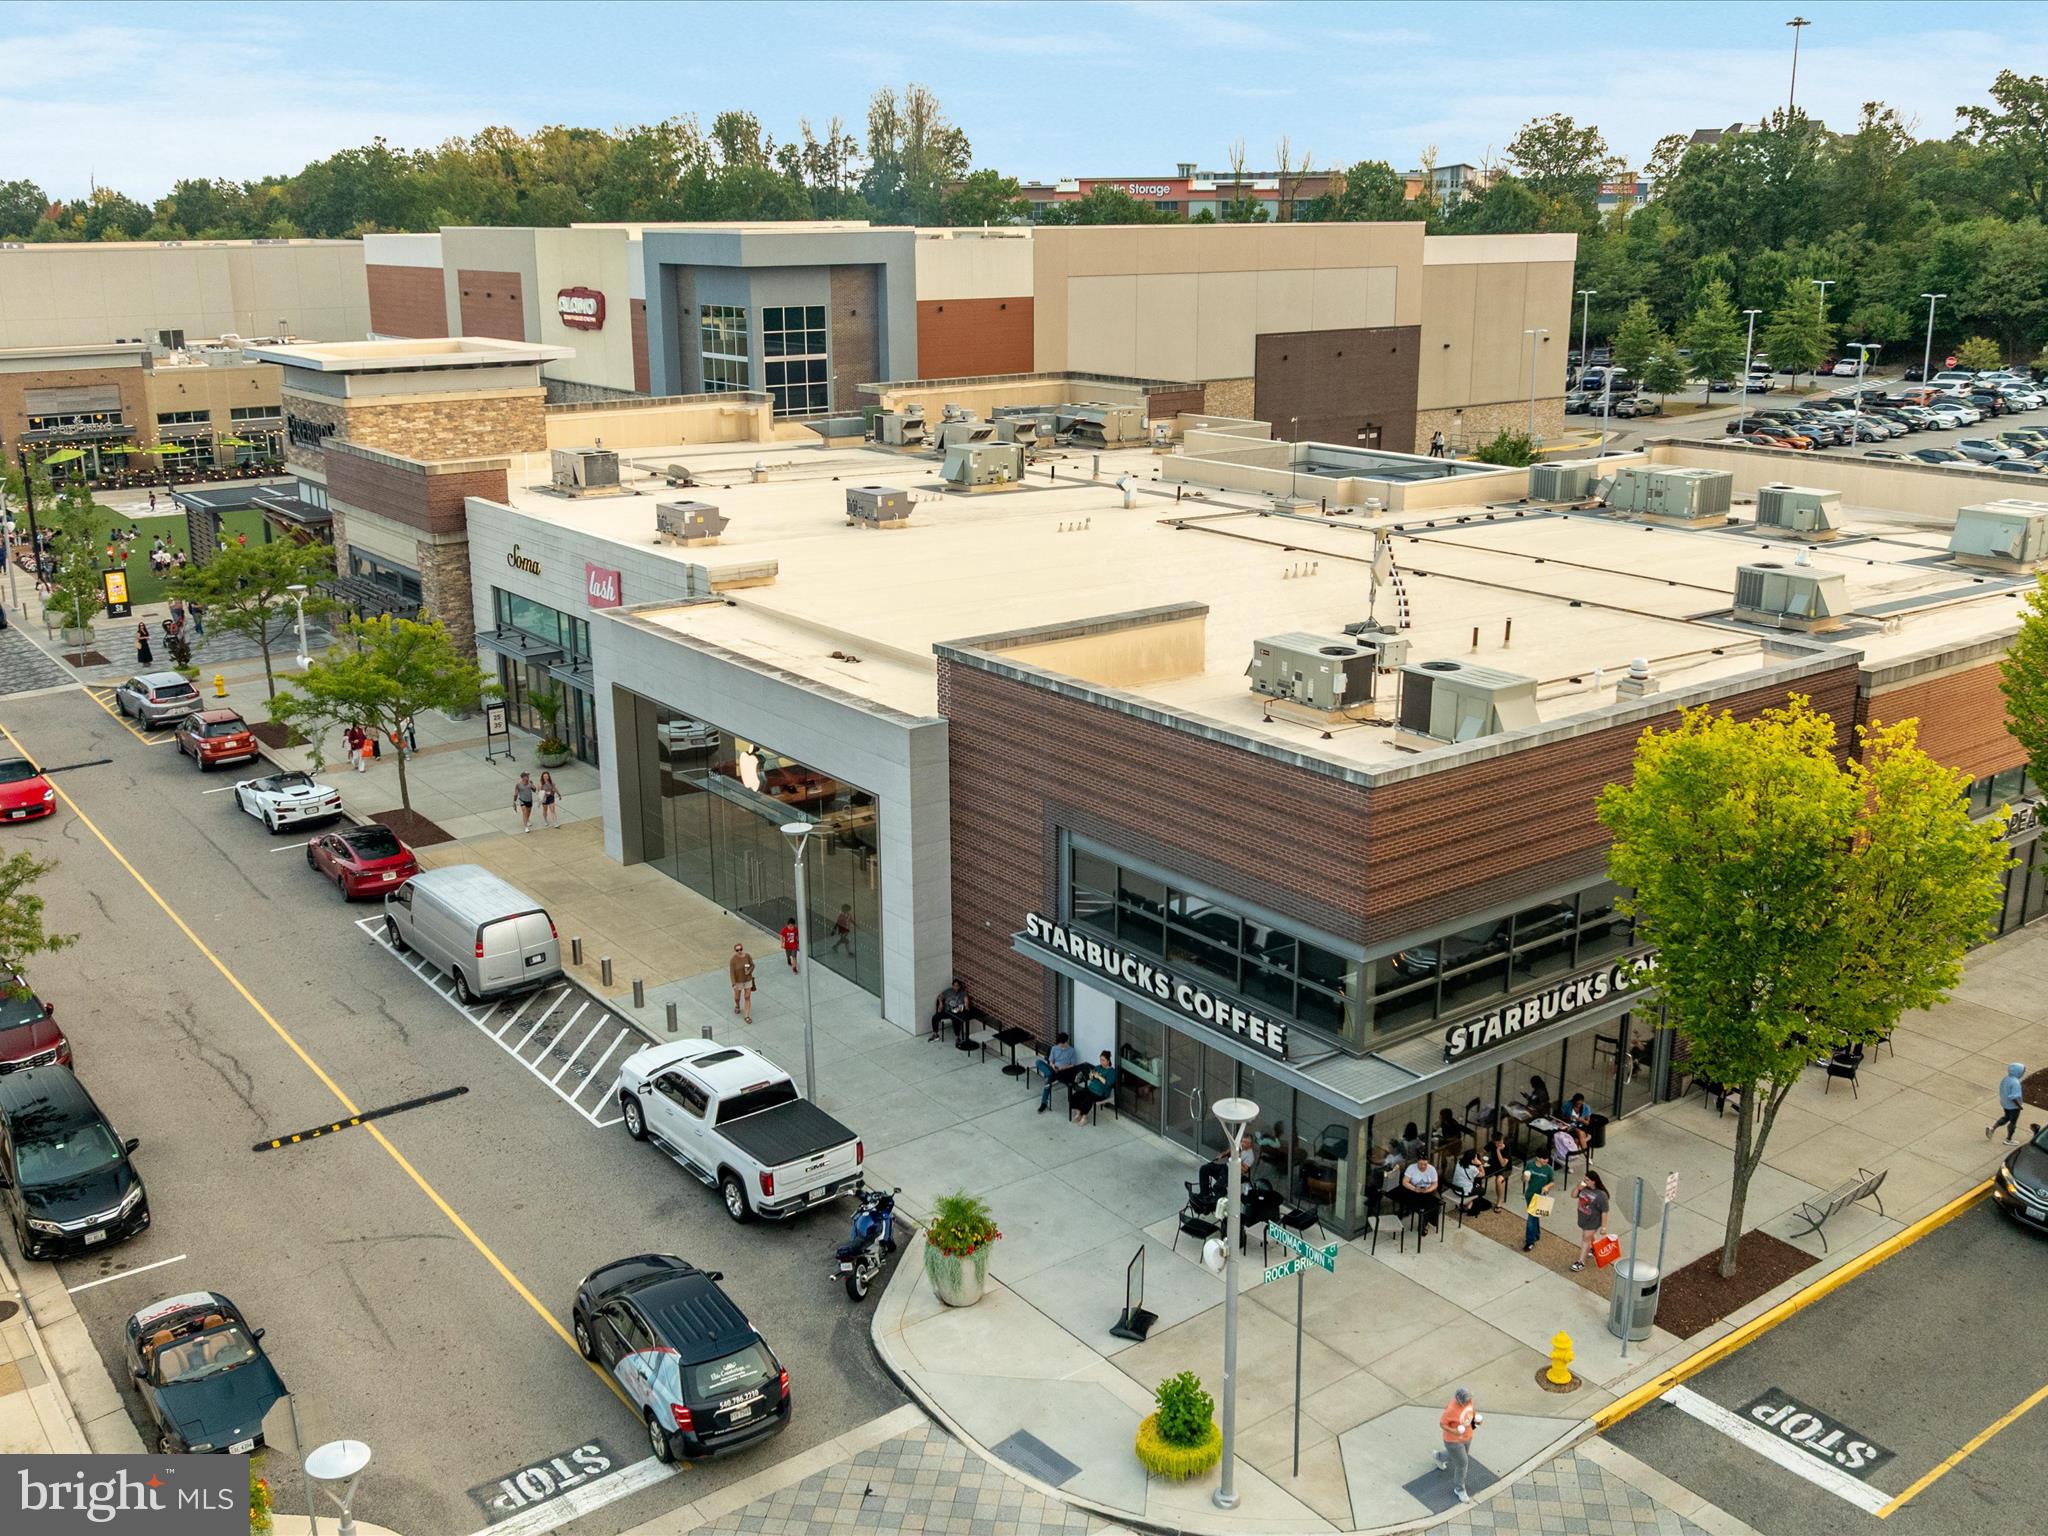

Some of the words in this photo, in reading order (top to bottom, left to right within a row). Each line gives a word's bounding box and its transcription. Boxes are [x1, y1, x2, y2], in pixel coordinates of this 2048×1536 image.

[1129, 184, 1170, 201] Storage
[507, 543, 541, 576] Soma
[1026, 912, 1170, 1000] STARBUCKS
[1177, 984, 1284, 1054] COFFEE
[1451, 973, 1608, 1056] STARBUCKS
[1535, 1208, 1550, 1217] CAVA
[1269, 1224, 1302, 1253] POTOMAC
[1305, 1245, 1325, 1267] TOWN
[1265, 1263, 1290, 1283] ROCK
[1751, 1404, 1877, 1469] STOP
[491, 1445, 611, 1510] STOP
